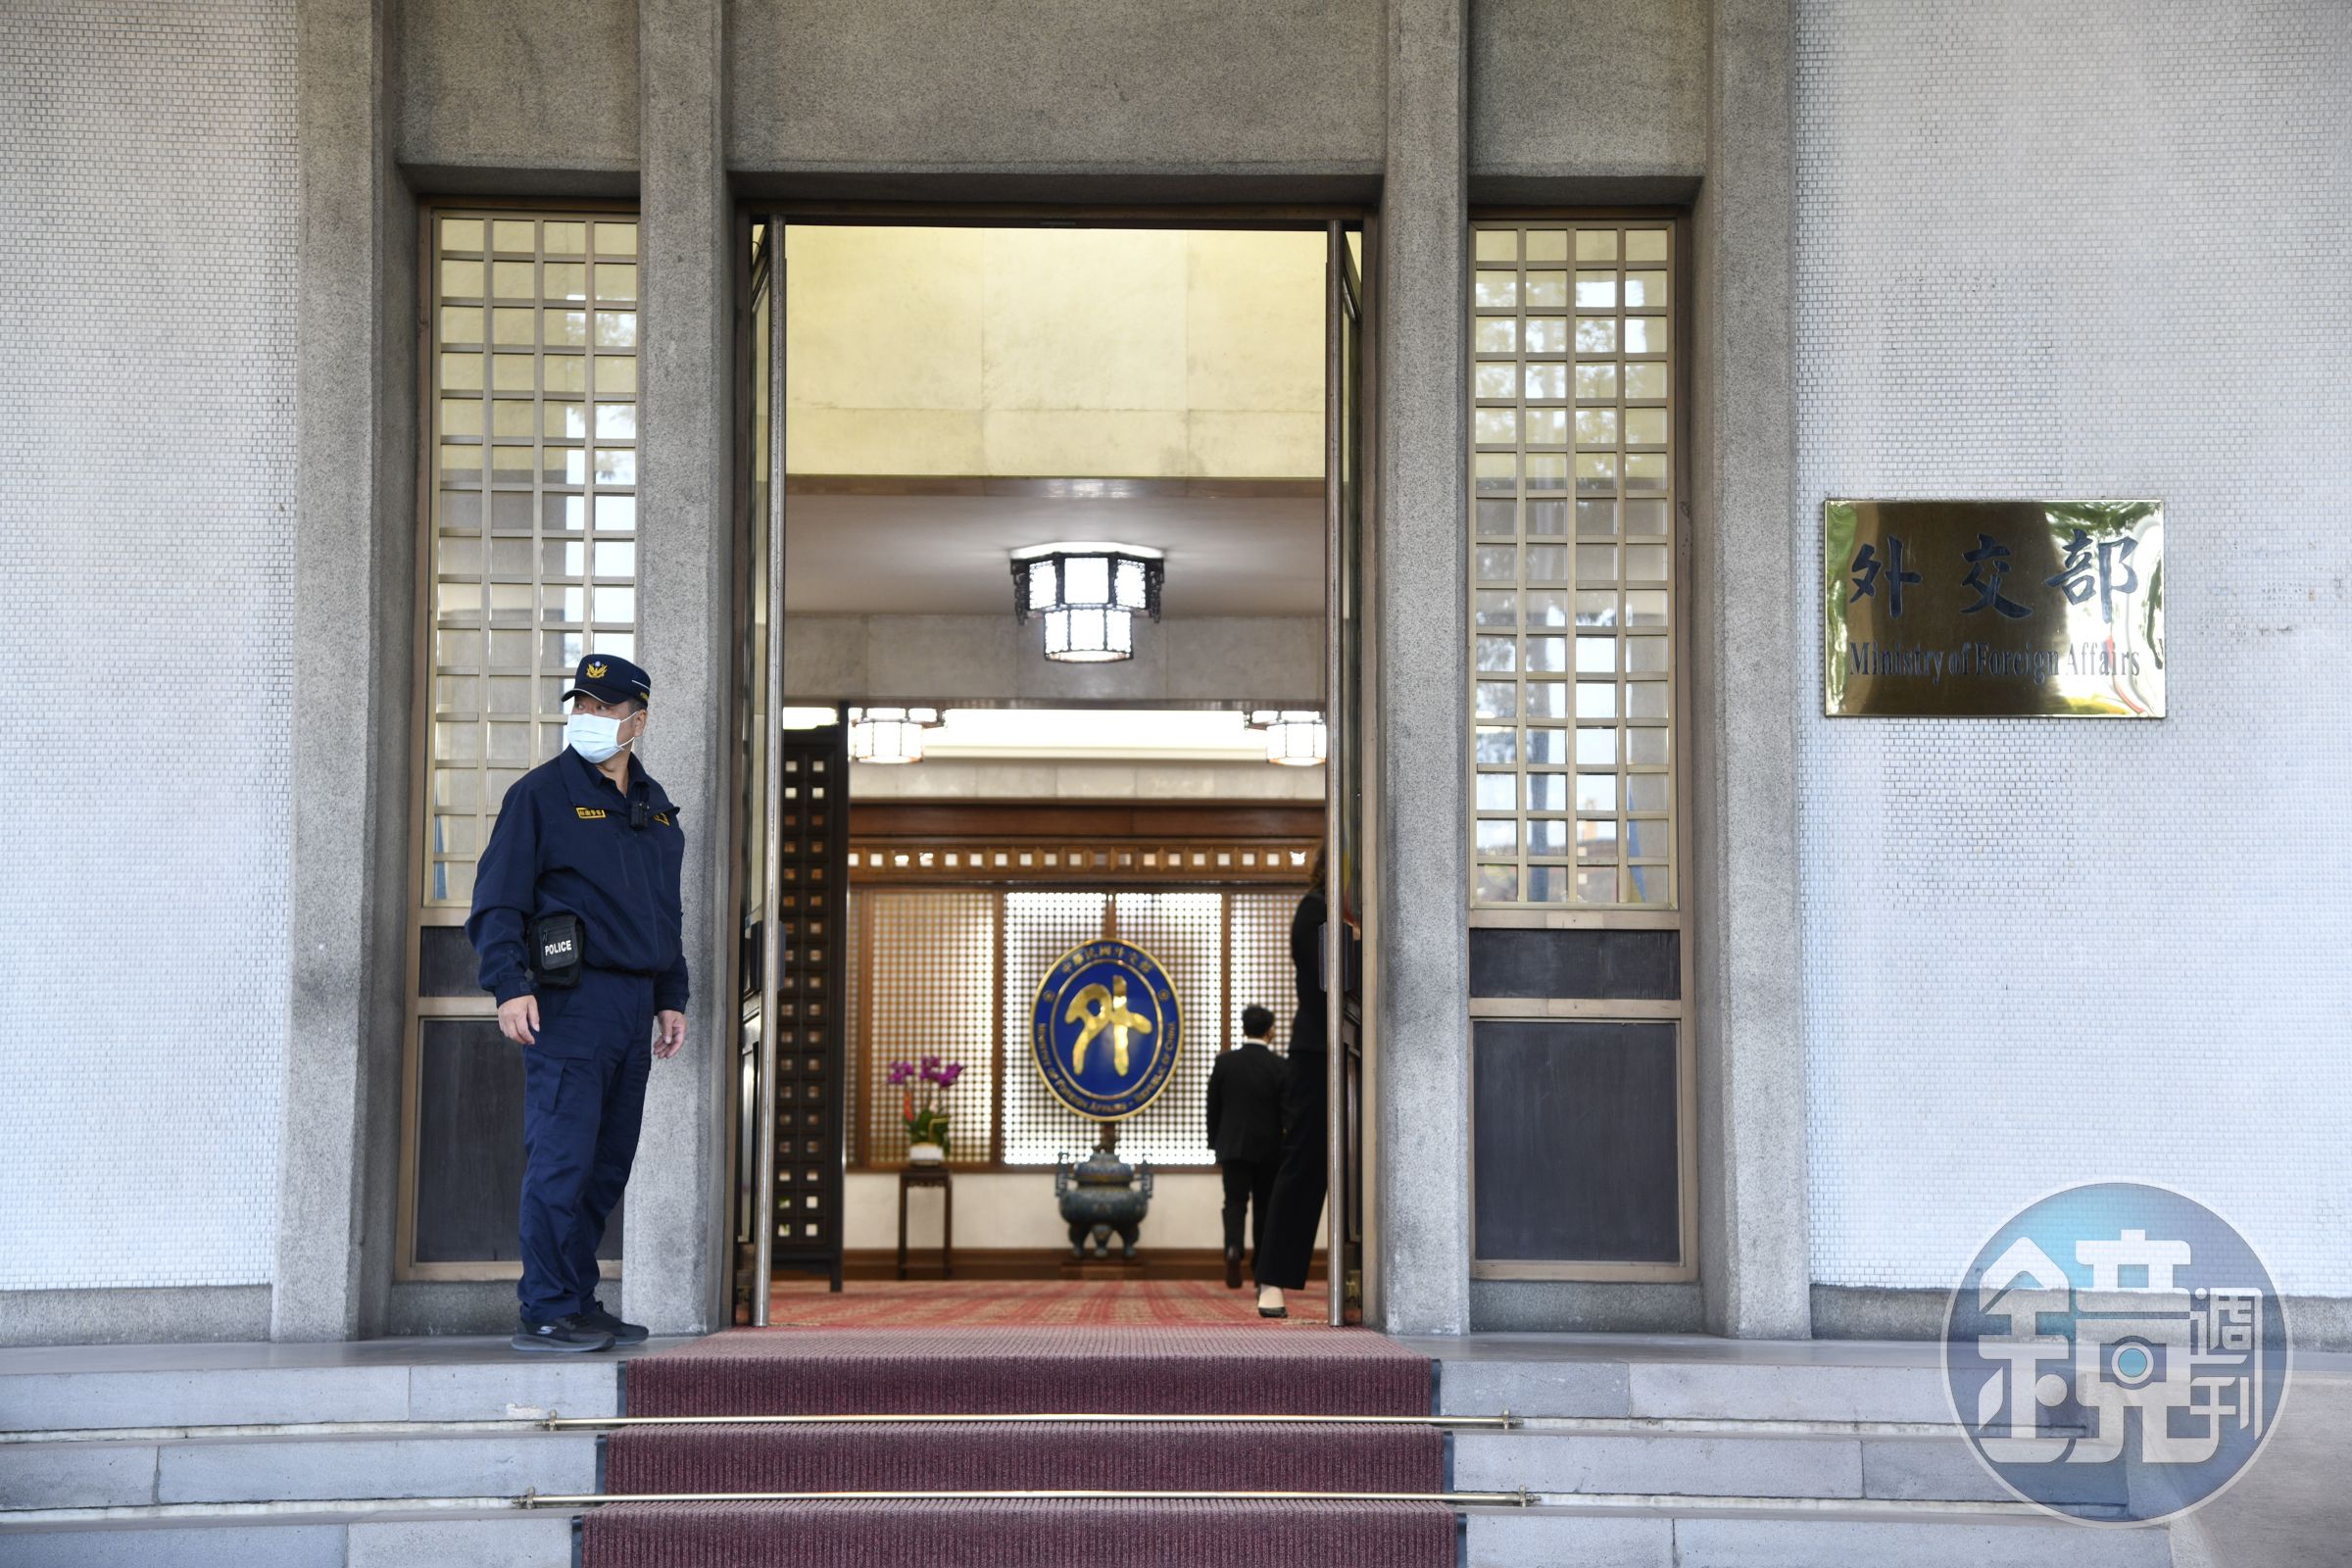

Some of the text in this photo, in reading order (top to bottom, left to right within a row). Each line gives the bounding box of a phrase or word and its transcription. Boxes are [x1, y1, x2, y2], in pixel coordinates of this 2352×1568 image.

[1849, 529, 2138, 624] 外交部
[1849, 642, 2140, 686] Ministry of Foreign Affairs
[544, 940, 572, 956] POLICE
